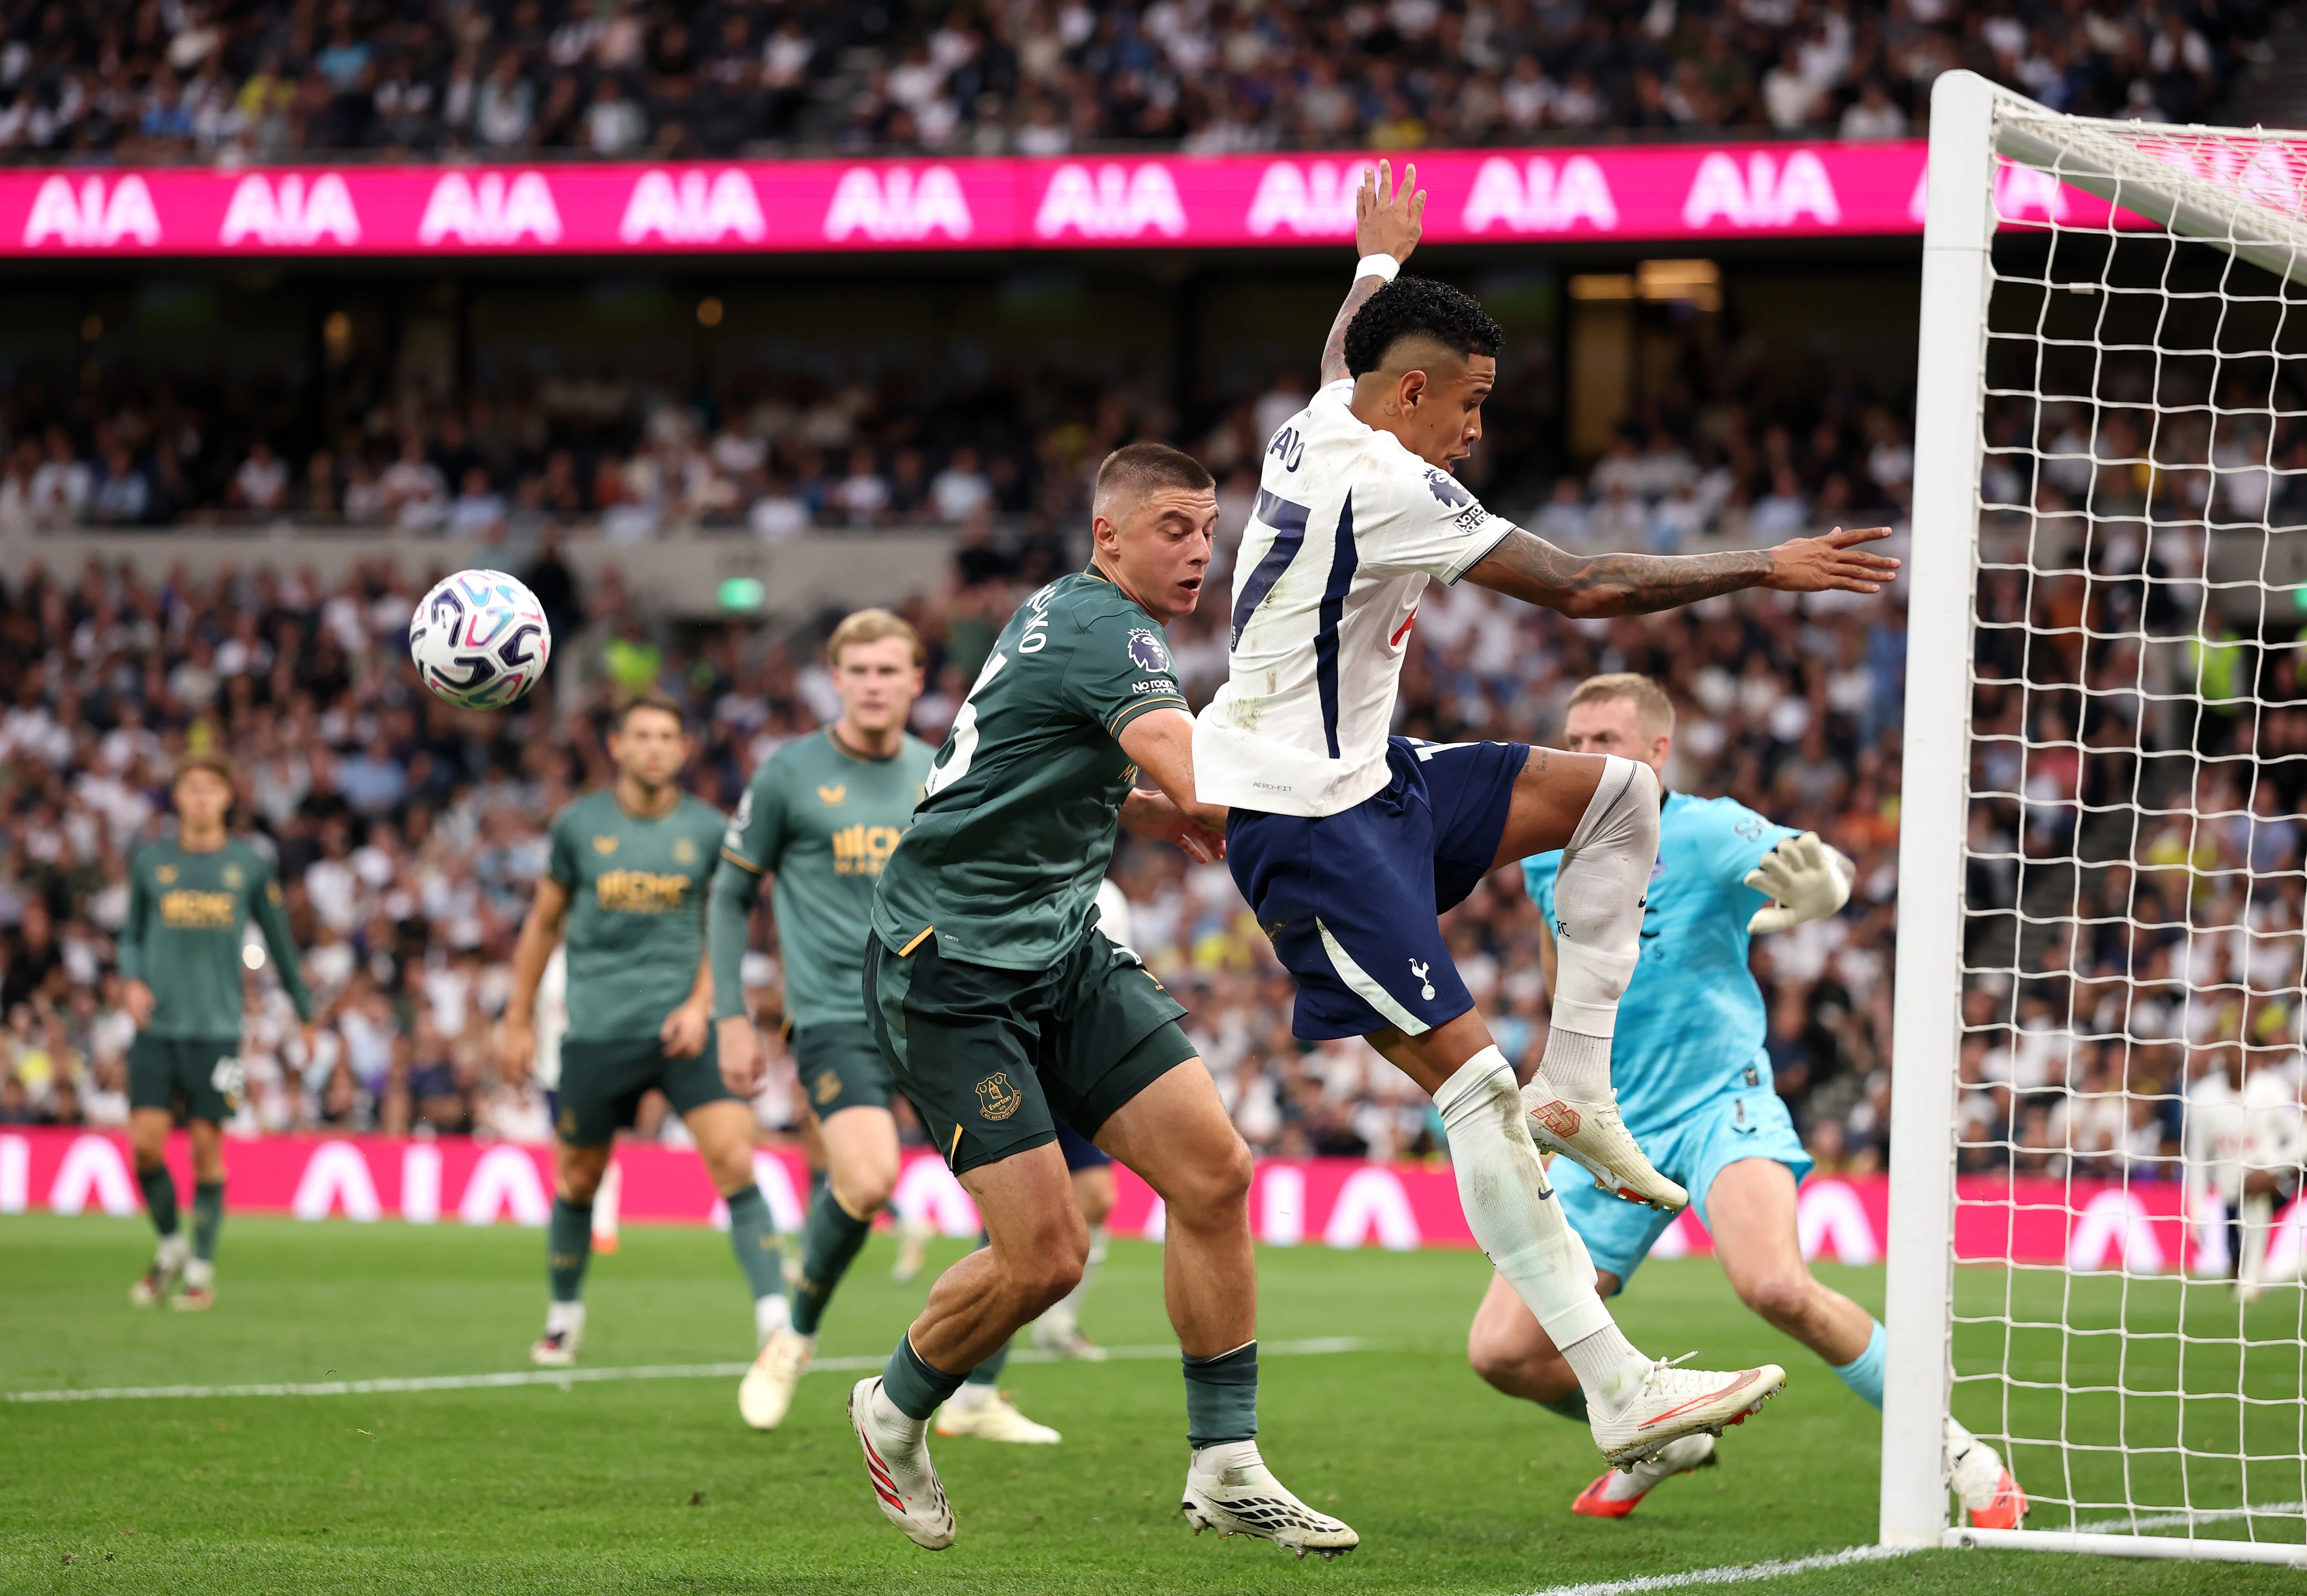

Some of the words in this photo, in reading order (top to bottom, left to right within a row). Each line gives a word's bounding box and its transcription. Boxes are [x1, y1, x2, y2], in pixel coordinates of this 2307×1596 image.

[23, 174, 161, 247] AIA
[220, 173, 361, 246] AIA
[418, 171, 563, 245] AIA
[620, 169, 766, 244] AIA
[824, 166, 973, 241] AIA
[1035, 163, 1187, 238] AIA
[1462, 155, 1619, 232] AIA
[1682, 150, 1841, 228] AIA
[1454, 514, 1472, 530] No
[1461, 520, 1478, 534] for
[1231, 487, 1311, 654] 7
[1131, 681, 1149, 693] No
[1150, 680, 1175, 689] room
[925, 639, 1009, 798] 6
[1253, 782, 1293, 792] AERO-FIT
[1556, 919, 1571, 938] FC
[988, 1096, 1012, 1111] Everton
